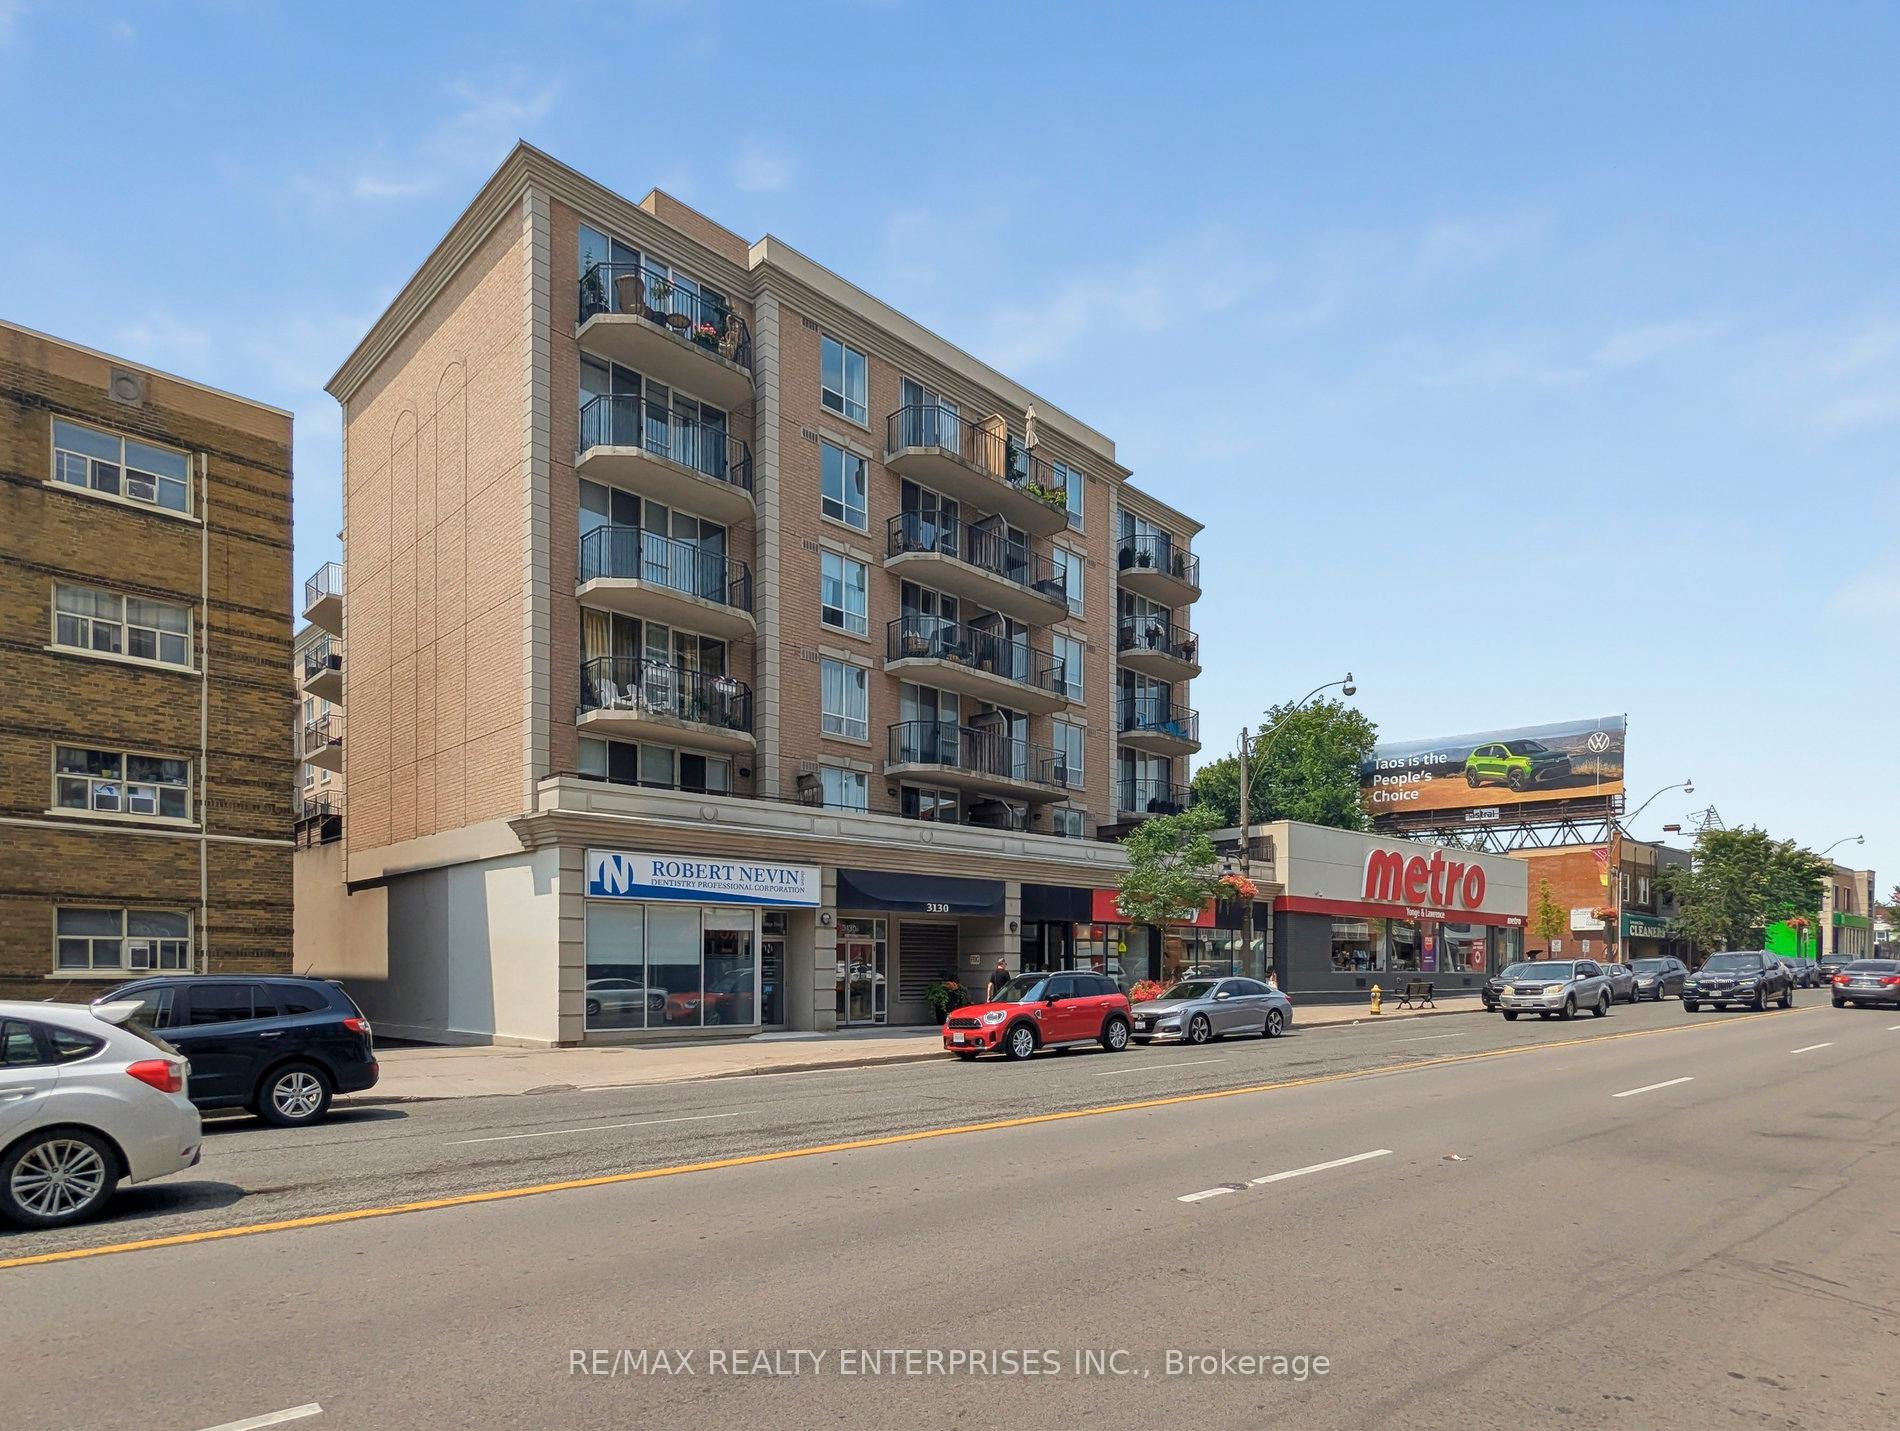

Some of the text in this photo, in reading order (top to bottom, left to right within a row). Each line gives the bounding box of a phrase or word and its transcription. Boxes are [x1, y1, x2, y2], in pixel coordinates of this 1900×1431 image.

[1374, 752, 1448, 770] Taos is the
[1373, 770, 1432, 787] People's
[1373, 788, 1419, 802] Choice
[652, 861, 799, 885] ROBERT NEVIN
[1361, 849, 1486, 909] metro
[651, 878, 805, 894] DENTISTRY PROFESSIONAL CORPORATION
[926, 903, 949, 913] 3130
[1507, 917, 1521, 925] metro
